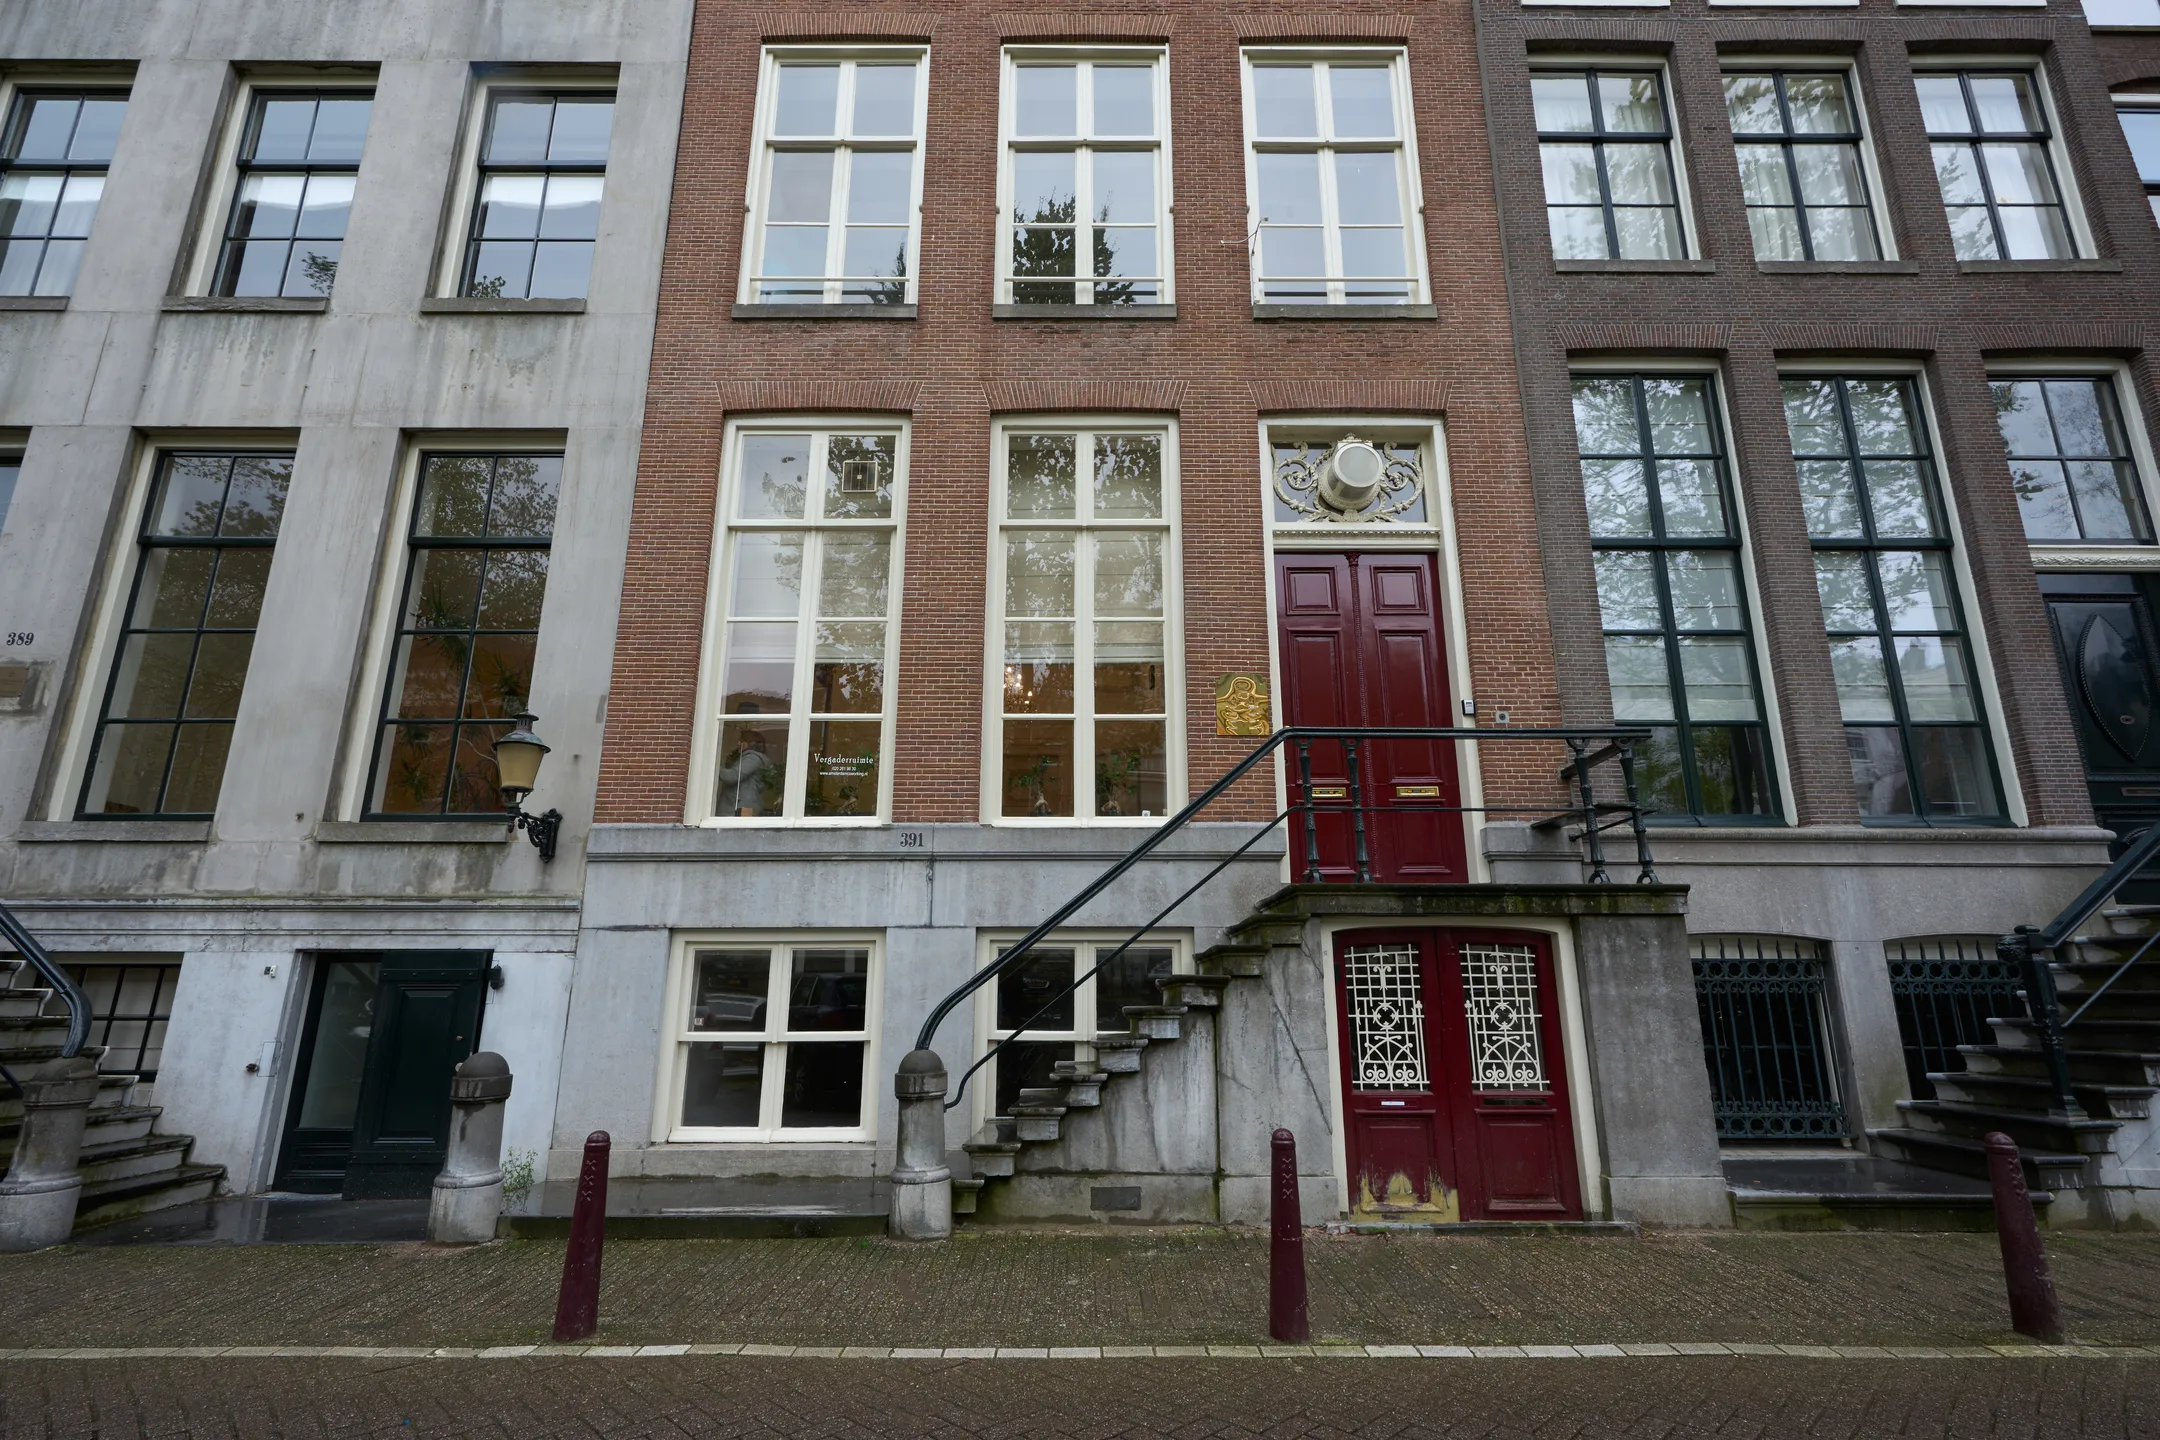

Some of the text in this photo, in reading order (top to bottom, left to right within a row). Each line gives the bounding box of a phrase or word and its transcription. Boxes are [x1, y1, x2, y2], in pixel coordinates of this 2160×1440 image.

[6, 631, 35, 646] 389
[814, 753, 874, 765] Vergaderruimte
[900, 832, 924, 848] 391
